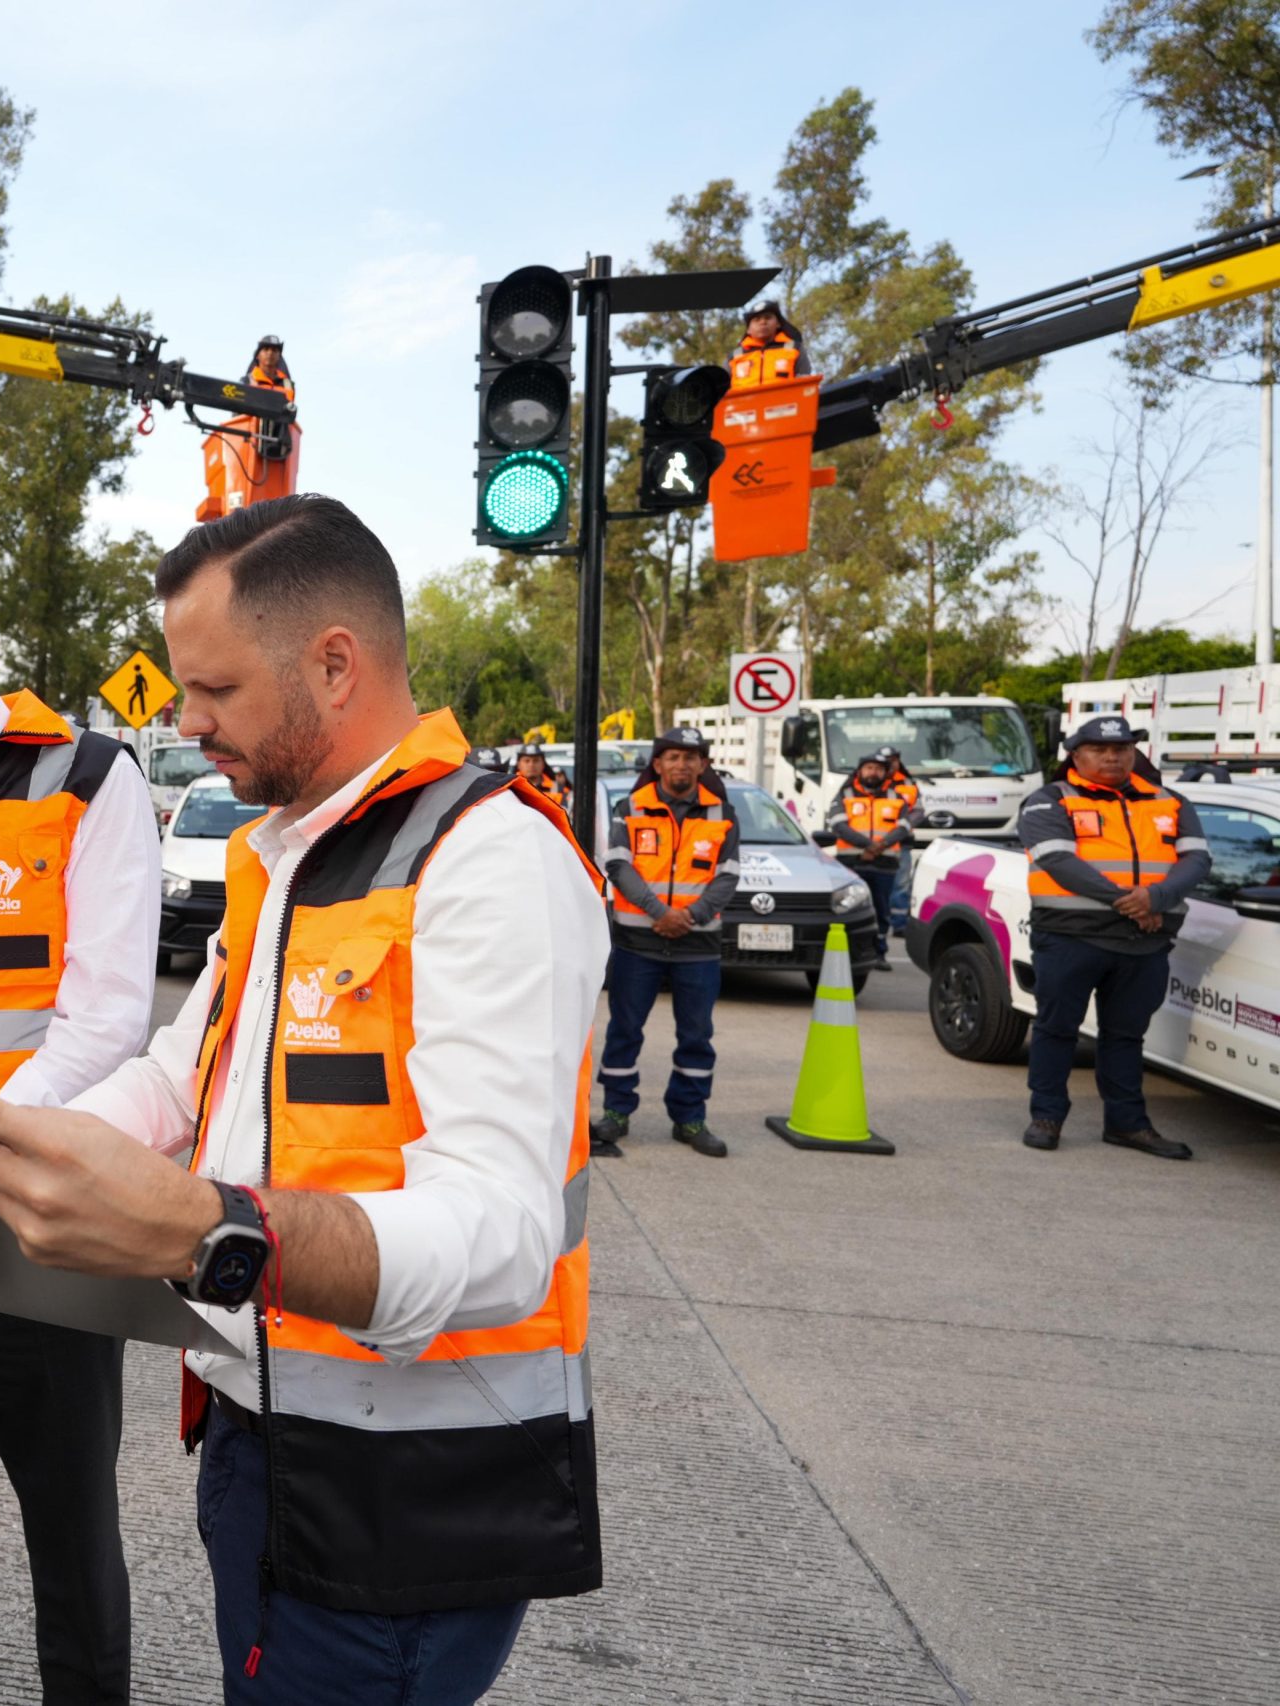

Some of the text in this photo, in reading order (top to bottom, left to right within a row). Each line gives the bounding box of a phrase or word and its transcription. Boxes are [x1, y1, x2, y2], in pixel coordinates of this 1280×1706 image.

[753, 670, 778, 700] E
[1171, 976, 1232, 1015] Puebla
[284, 1021, 341, 1041] Puebla
